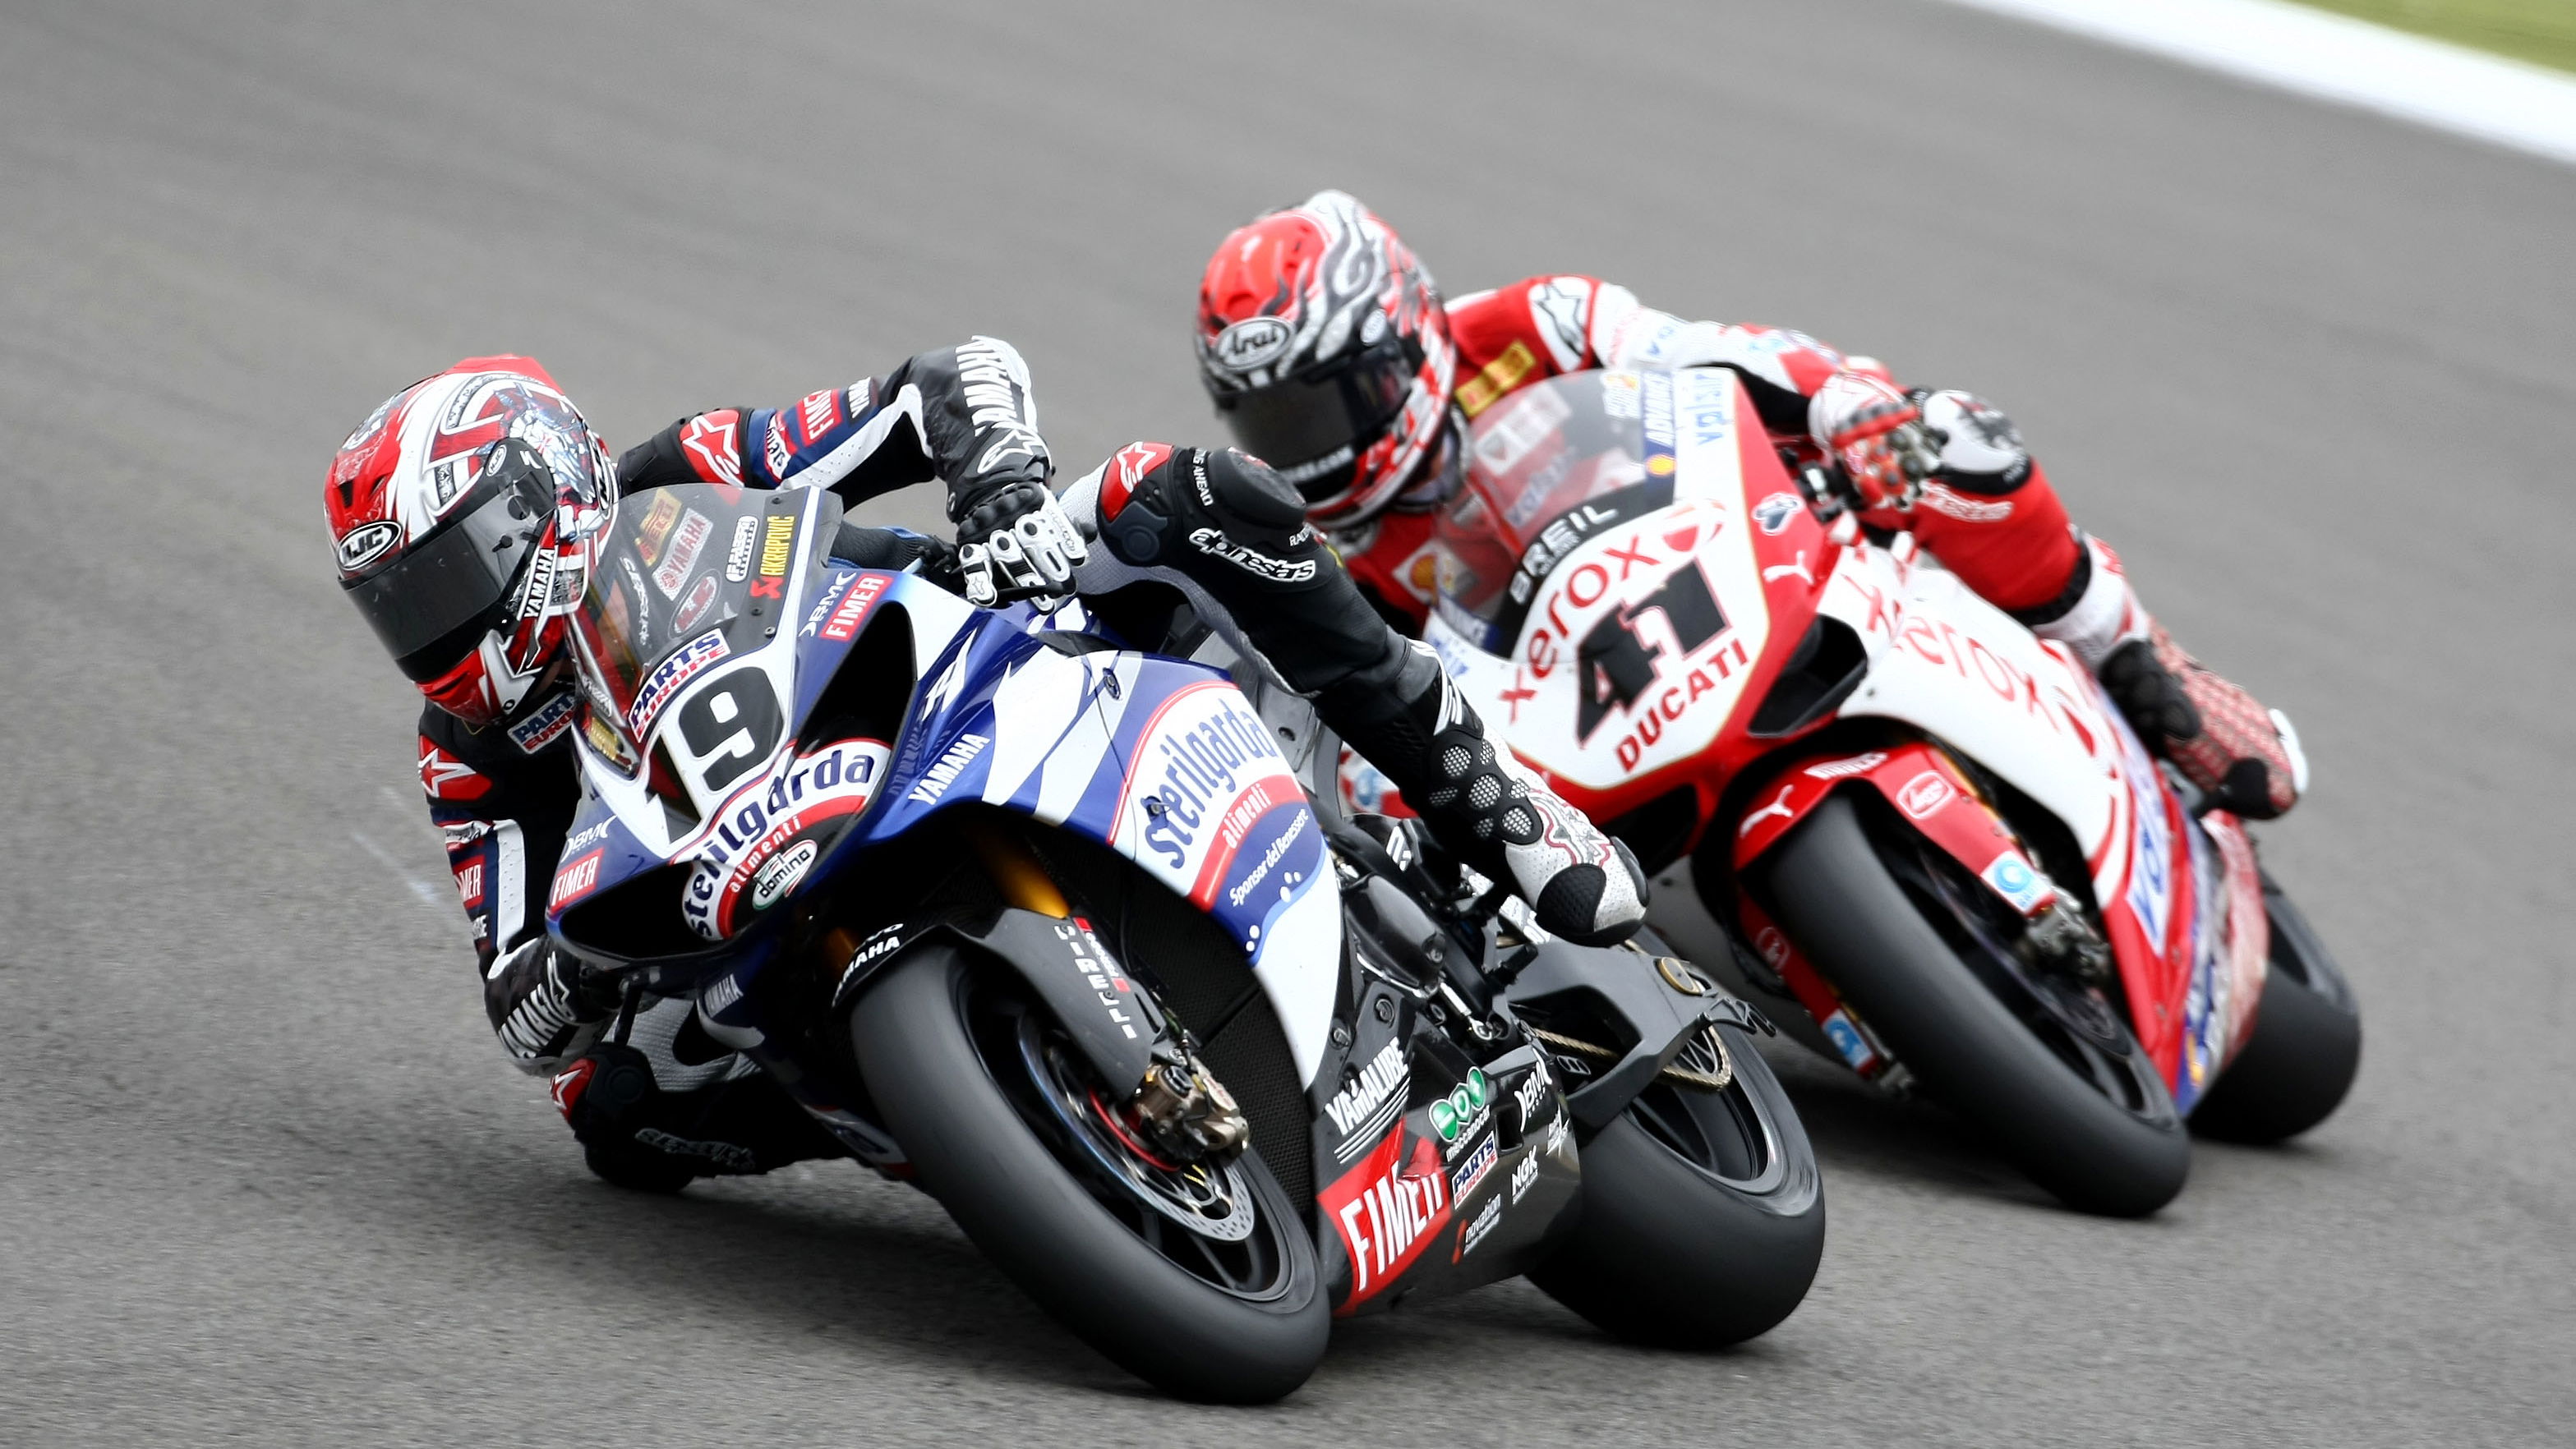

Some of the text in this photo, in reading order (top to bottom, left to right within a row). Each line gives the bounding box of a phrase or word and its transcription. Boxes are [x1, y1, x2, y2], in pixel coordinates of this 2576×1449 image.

[809, 389, 835, 440] FIME
[1193, 467, 1212, 507] AHEAD
[668, 515, 706, 582] YAMAHA
[1509, 506, 1617, 604] BREIL
[524, 548, 555, 618] YAMAHA
[826, 577, 885, 638] FIMER
[1499, 536, 1661, 724] xerox
[1577, 557, 1732, 749] 41
[630, 632, 721, 728] PARTS
[638, 647, 726, 738] EUROPE
[1615, 638, 1748, 773] DUCATI
[908, 733, 990, 806] YAMAHA
[1144, 699, 1278, 870] sterilgarda
[684, 750, 877, 938] sterilgarda
[1222, 783, 1271, 849] alimenti
[551, 856, 599, 907] FIMER
[730, 816, 801, 893] alimenti
[758, 849, 811, 899] domino
[1229, 861, 1268, 907] Sponsor
[1265, 842, 1281, 868] del
[1445, 1104, 1491, 1162] meccanocar
[1453, 1134, 1496, 1192] PARTS
[1456, 1152, 1497, 1205] EUROPE
[1512, 1146, 1538, 1191] NGK
